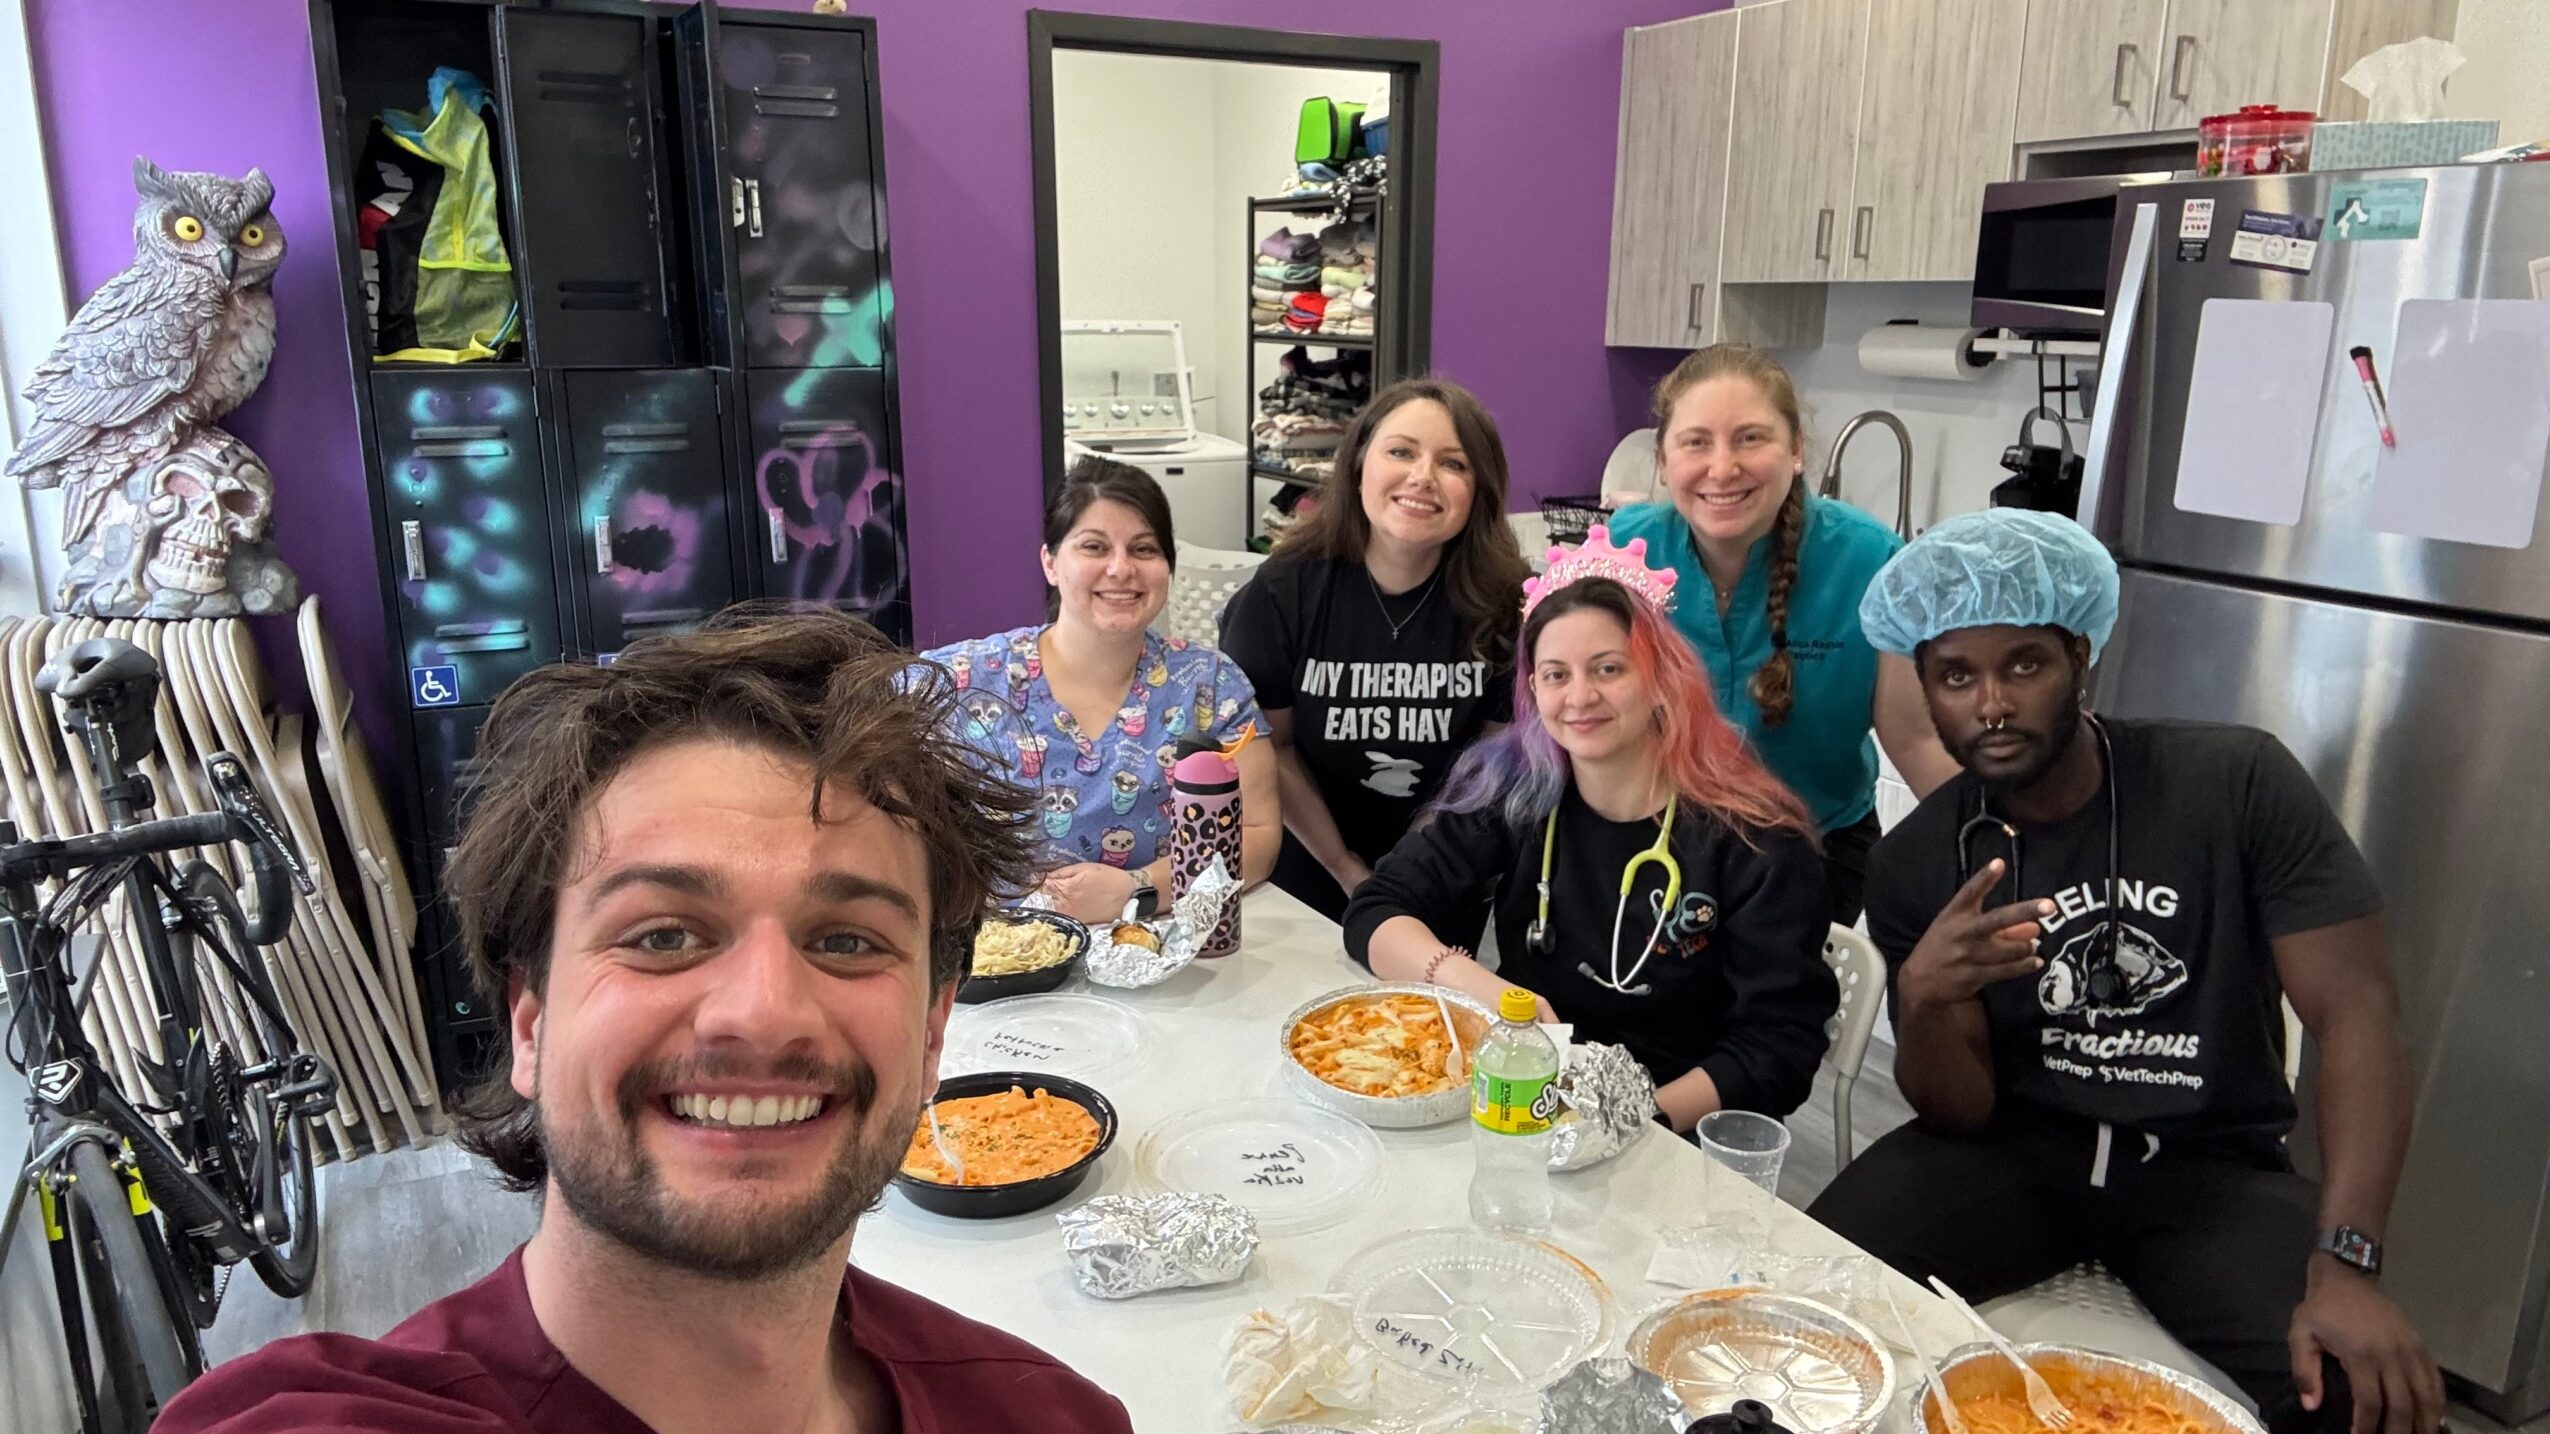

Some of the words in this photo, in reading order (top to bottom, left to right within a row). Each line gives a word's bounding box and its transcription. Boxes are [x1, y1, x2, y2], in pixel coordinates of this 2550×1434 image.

[1301, 657, 1344, 697] MY
[1350, 661, 1485, 699] THERAPIST
[1324, 706, 1391, 741] EATS
[1398, 707, 1452, 742] HAY
[2042, 1028, 2200, 1060] Fractious
[2043, 1055, 2093, 1079] VetPrep
[2114, 1066, 2204, 1090] VetTechPrep
[1504, 1082, 1512, 1122] RECYCLE
